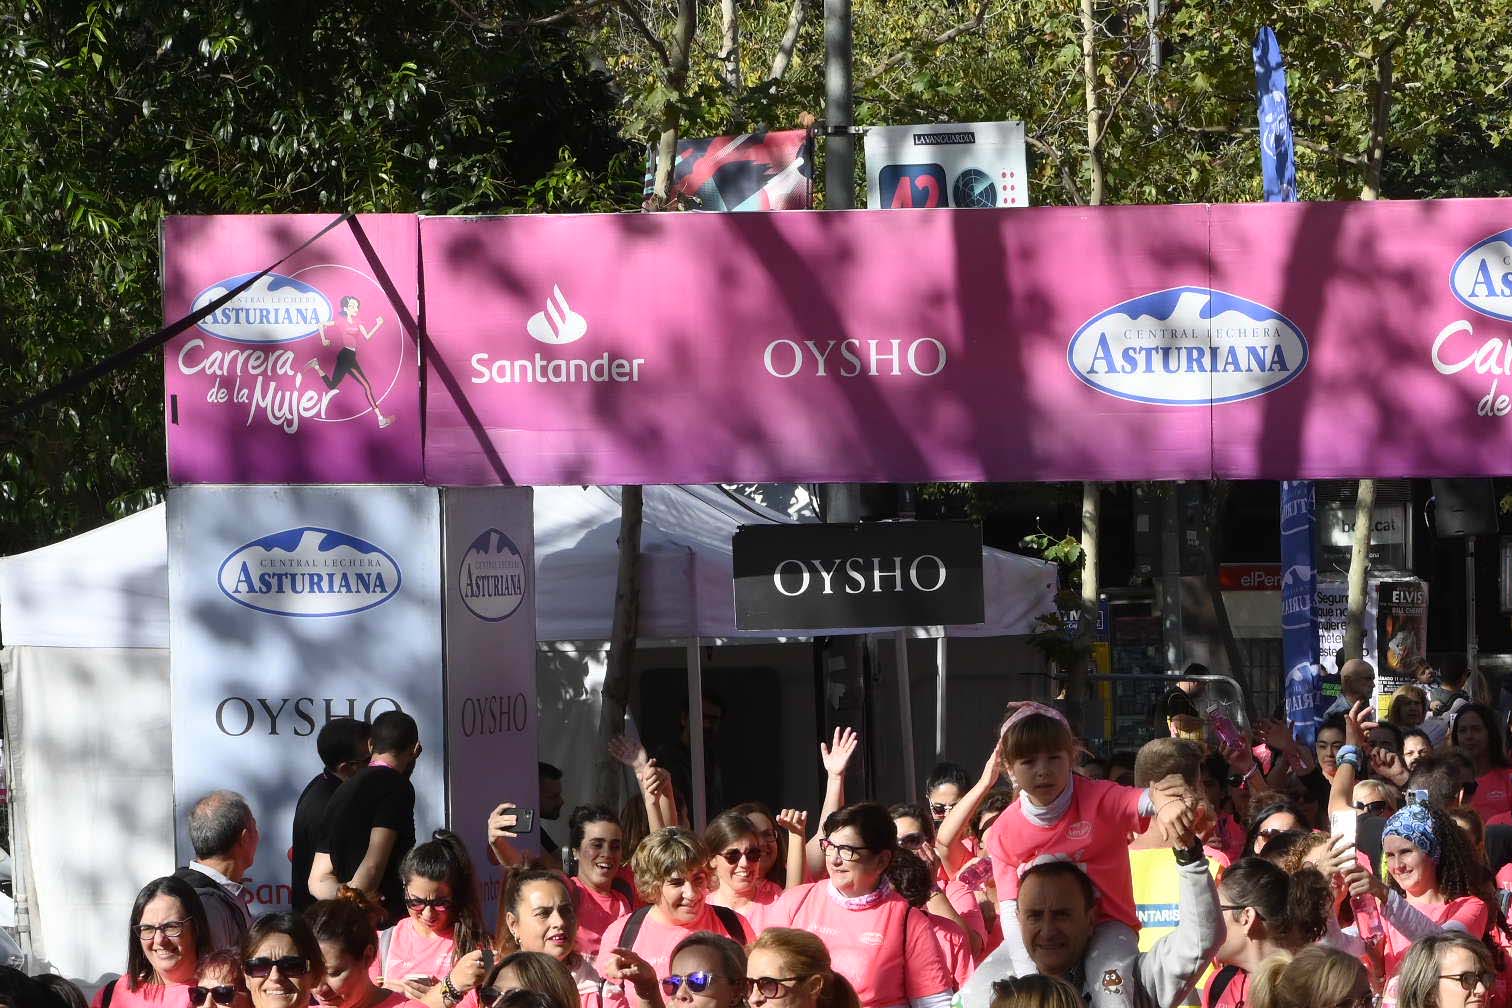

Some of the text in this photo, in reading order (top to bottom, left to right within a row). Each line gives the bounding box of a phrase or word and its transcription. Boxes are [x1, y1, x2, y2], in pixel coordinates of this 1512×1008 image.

[1123, 327, 1282, 340] CENTRAL LECHERA
[178, 339, 294, 377] Carrera
[471, 352, 645, 385] Santander
[763, 337, 947, 379] OYSHO
[1087, 339, 1290, 375] ASTURIANA
[207, 374, 340, 434] de la Mujer
[1477, 385, 1512, 418] de
[232, 561, 388, 594] ASTURIANA
[260, 558, 382, 567] CENTRAL LECHERA
[774, 554, 946, 597] OYSHO
[1241, 571, 1281, 586] elPer
[464, 564, 522, 599] ASTURIANA
[1317, 592, 1349, 604] Segur
[1392, 591, 1424, 603] ELVIS
[461, 692, 528, 738] OYSHO
[1136, 910, 1180, 922] NTARIS
